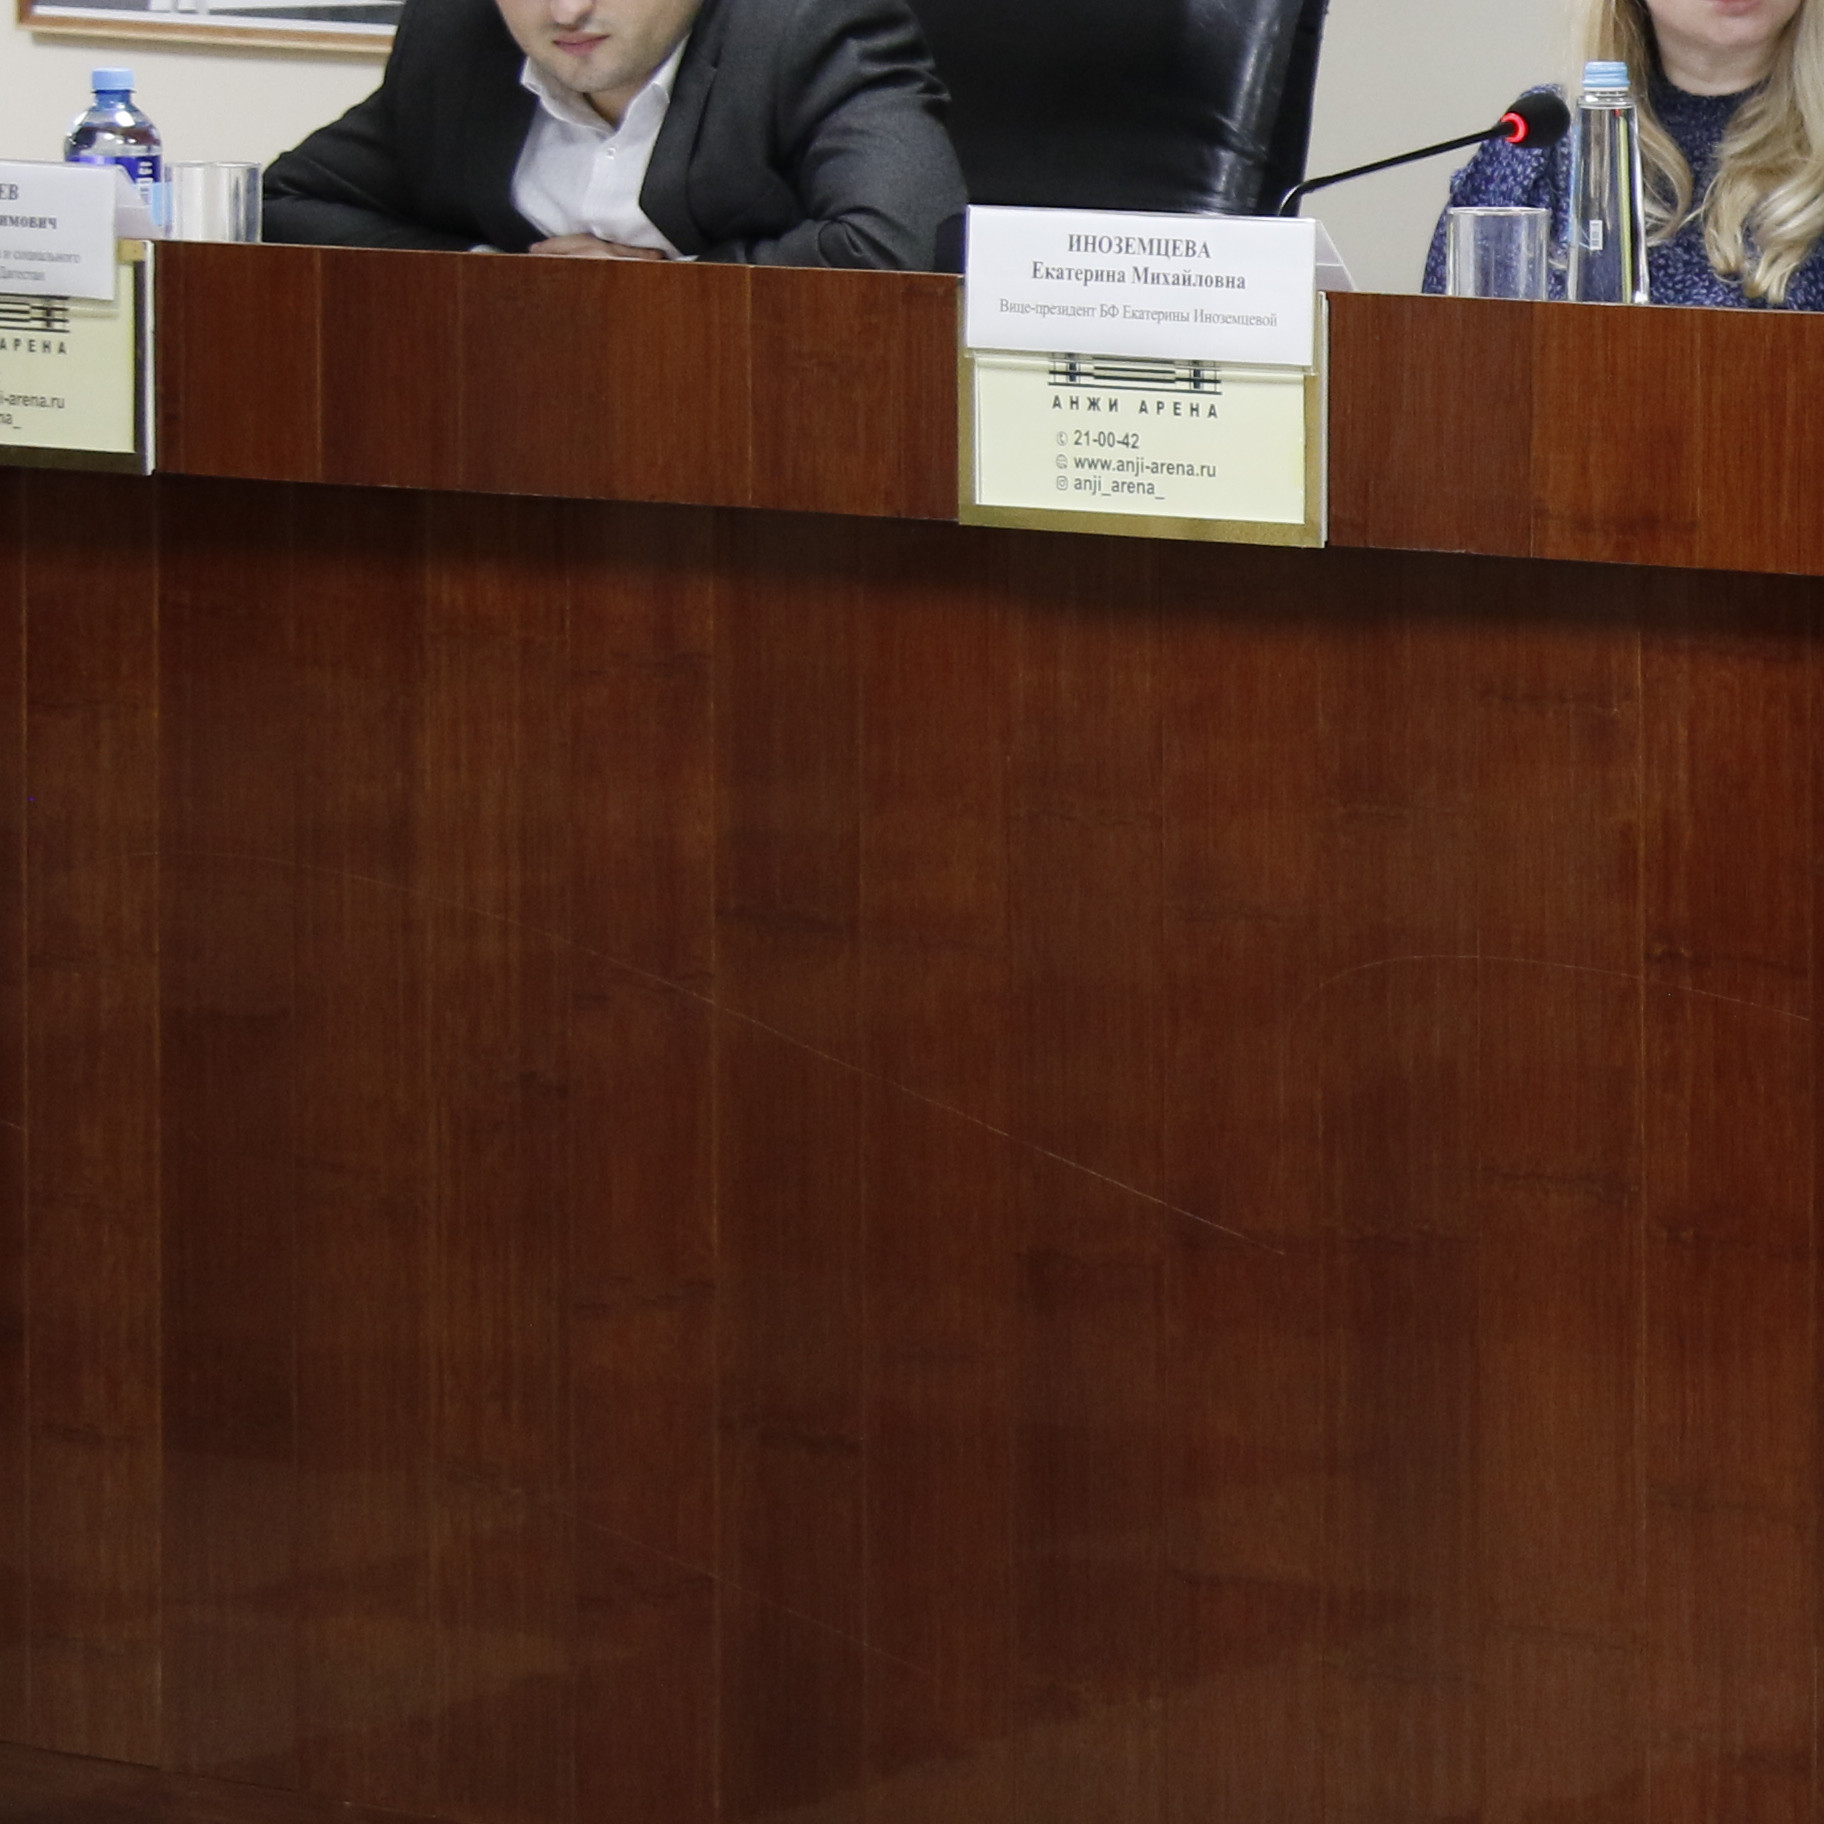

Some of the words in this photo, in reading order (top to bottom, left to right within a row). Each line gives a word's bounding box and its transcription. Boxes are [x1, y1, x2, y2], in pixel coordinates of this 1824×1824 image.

[1067, 233, 1211, 260] ИНОЗЕМЦЕВА
[1032, 261, 1126, 285] Екатерина
[1132, 264, 1246, 290] Михайловна
[1000, 299, 1096, 318] Вице-президент
[1100, 304, 1119, 319] БФ
[1123, 306, 1189, 323] Екатерины
[1193, 309, 1278, 328] Иноземцевой
[1052, 396, 1119, 413] АНЖИ
[1139, 399, 1218, 418] АРЕНА
[1073, 430, 1139, 449] 21-00-42
[1074, 456, 1216, 477] www.anji-arena.ru
[1073, 476, 1165, 500] anji_arena_
